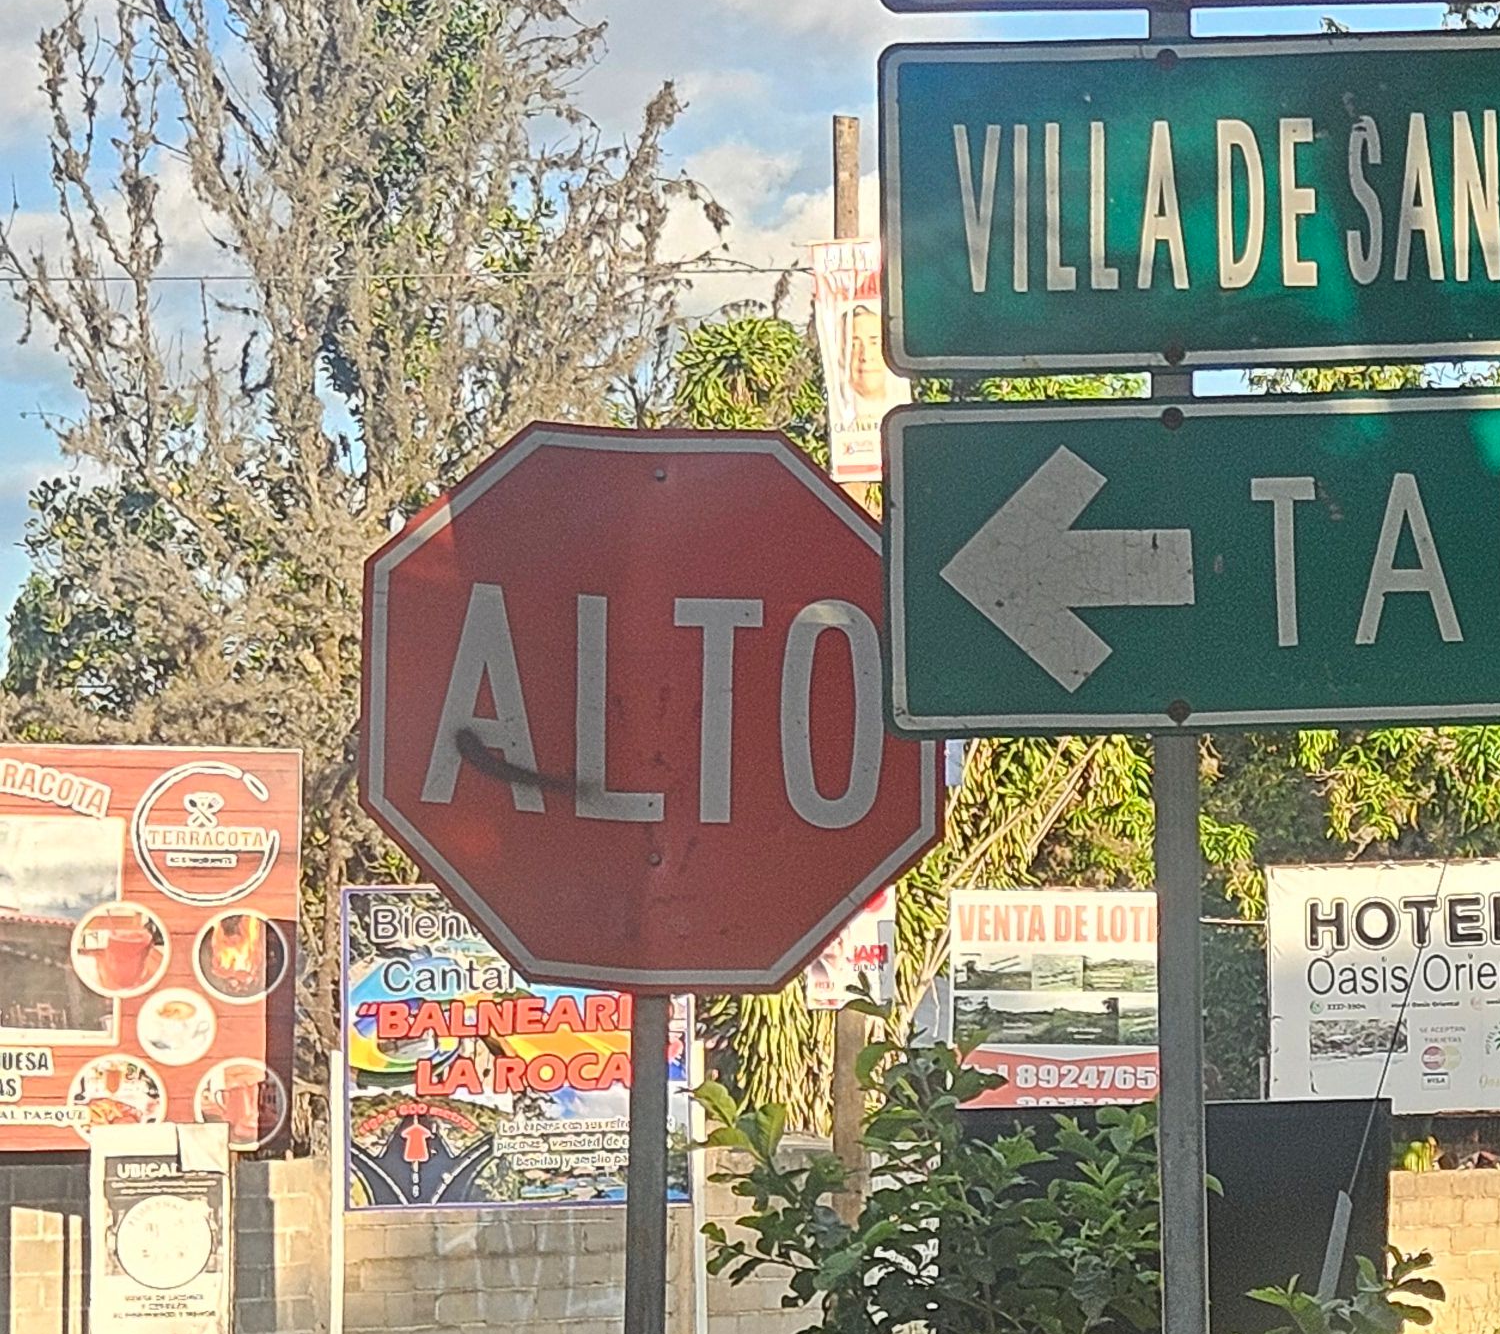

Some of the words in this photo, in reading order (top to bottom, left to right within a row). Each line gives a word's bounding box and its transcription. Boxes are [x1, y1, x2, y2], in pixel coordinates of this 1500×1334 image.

[952, 120, 1190, 293] VILLA
[1216, 117, 1319, 289] DE
[419, 582, 884, 830] ALTO
[148, 830, 265, 847] TERRACOTA
[957, 904, 1047, 943] VENTA
[1054, 904, 1090, 943] DE
[1307, 955, 1410, 995] Oasis
[416, 1057, 482, 1095] LA
